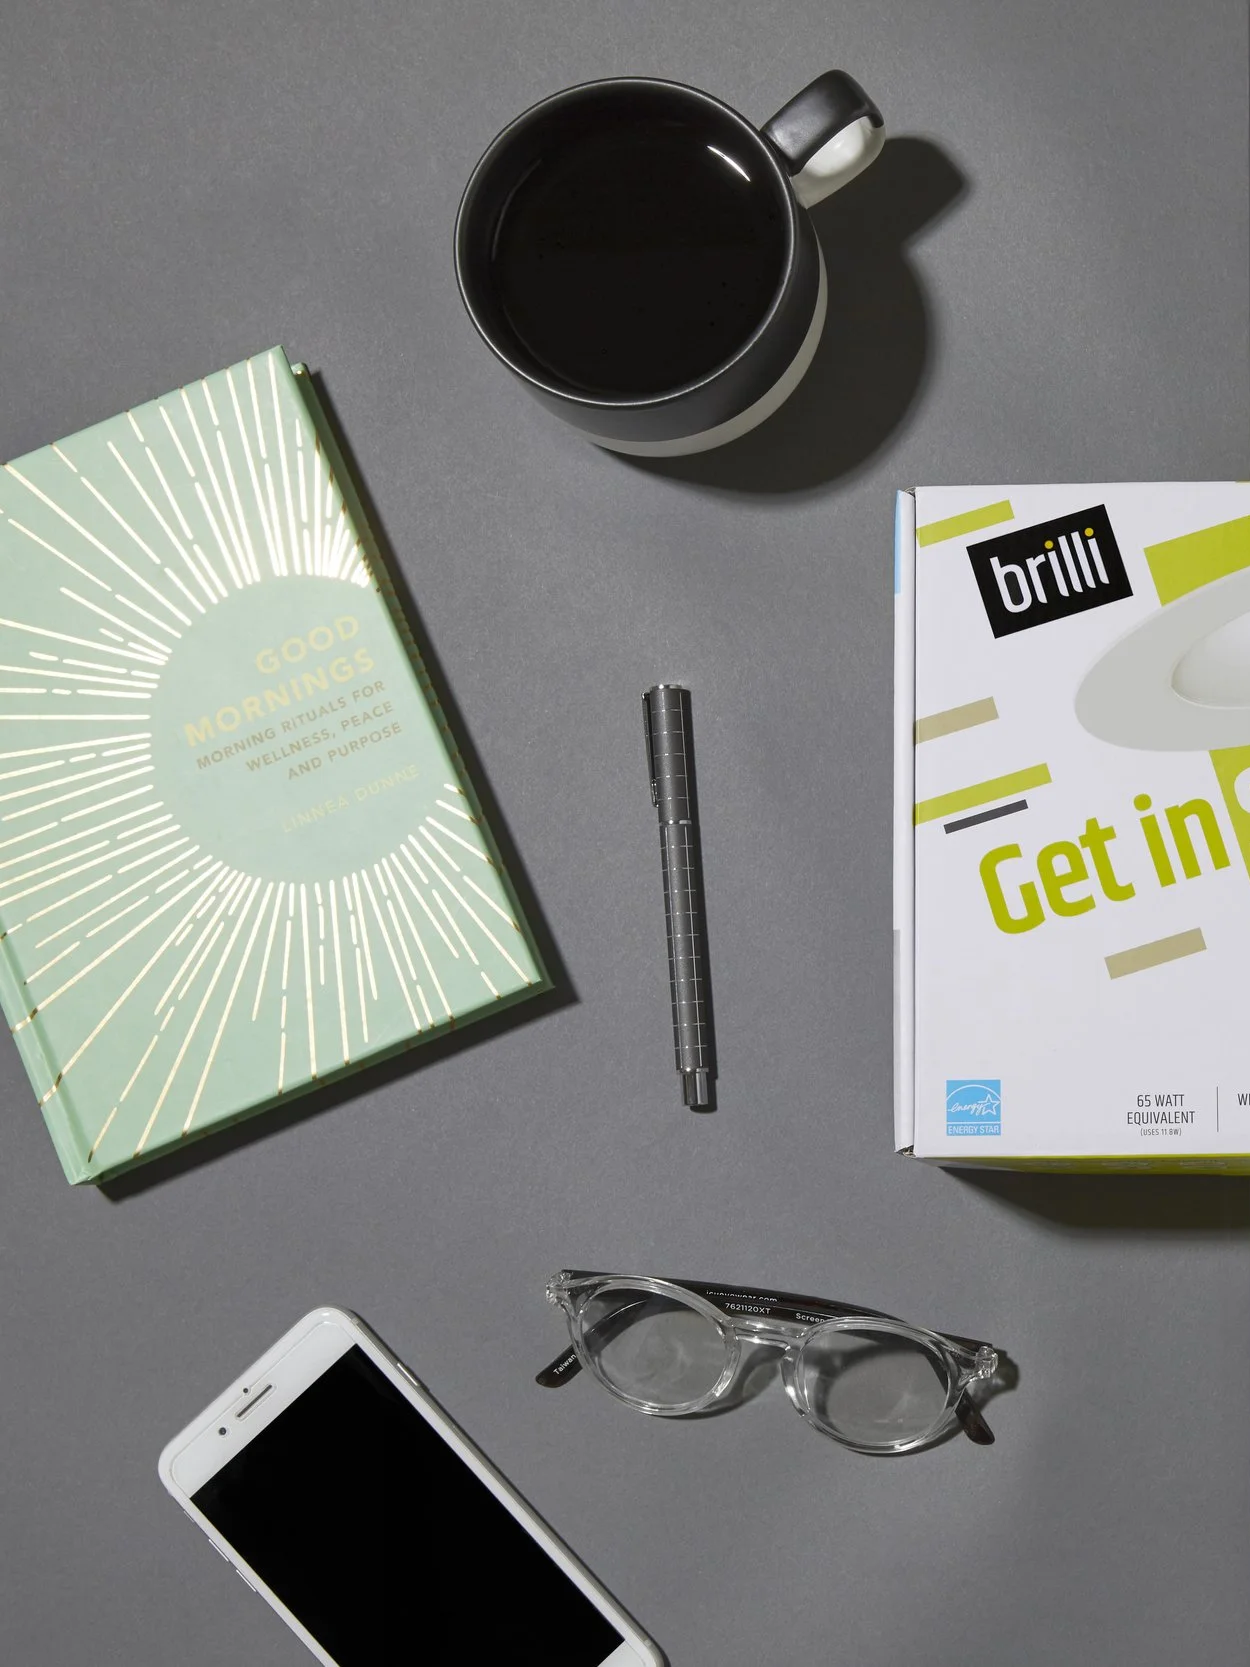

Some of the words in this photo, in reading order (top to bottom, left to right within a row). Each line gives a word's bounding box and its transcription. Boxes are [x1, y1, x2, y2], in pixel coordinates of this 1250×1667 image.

[989, 525, 1111, 614] brilli
[255, 615, 359, 675] GOOD
[183, 647, 375, 748] MORNINGS
[196, 727, 276, 770] MORNING
[281, 696, 347, 733] RITUALS
[352, 680, 386, 703] FOR
[246, 728, 337, 772] WELLNESS,
[340, 700, 394, 731] PEACE
[287, 756, 323, 780] AND
[328, 721, 403, 763] PURPOSE
[282, 794, 350, 833] LINNEA
[354, 764, 420, 802] DUNNE
[978, 815, 1137, 936] Get
[1132, 792, 1232, 888] in
[947, 1125, 978, 1135] ENERGY
[980, 1124, 1000, 1134] STAR
[948, 1102, 986, 1116] energy
[1127, 1110, 1195, 1126] EQUIVALENT
[1137, 1094, 1151, 1107] 65
[1154, 1093, 1185, 1107] WATT
[1140, 1127, 1160, 1137] (USES
[553, 1353, 577, 1375] Taiwan
